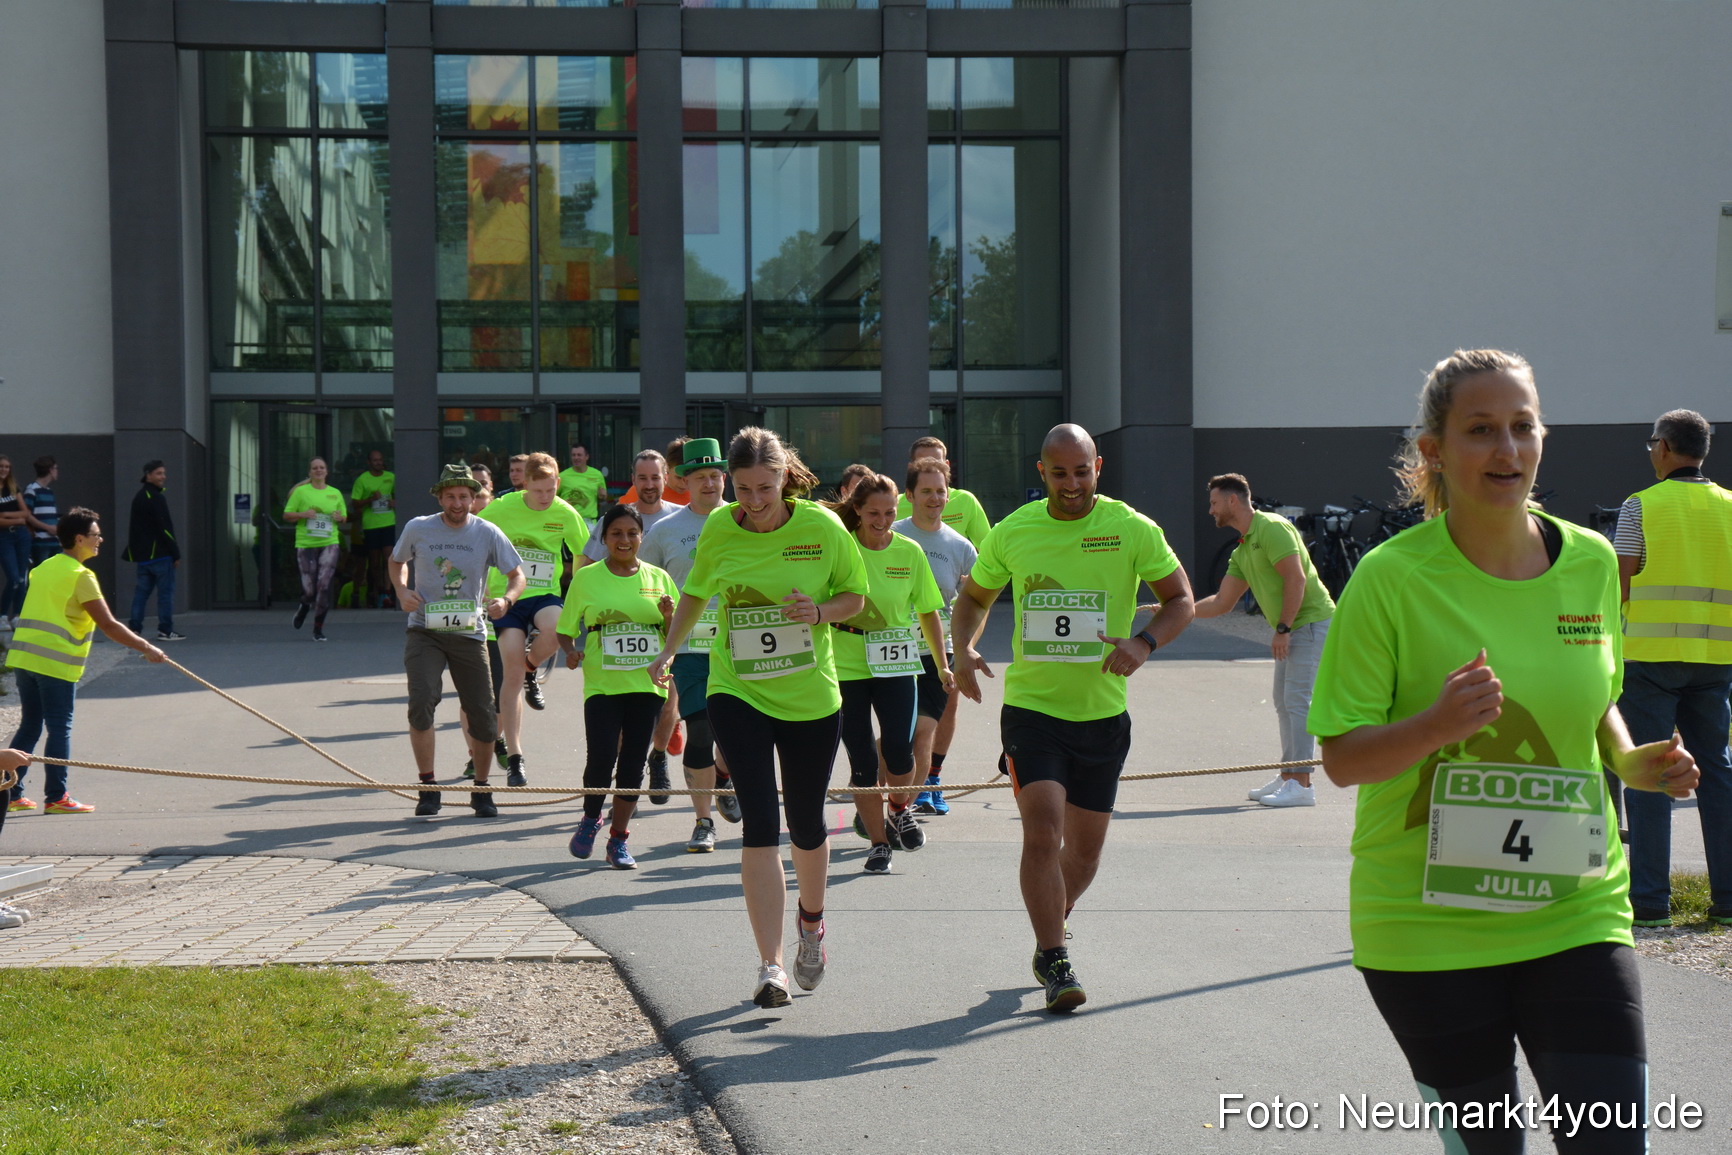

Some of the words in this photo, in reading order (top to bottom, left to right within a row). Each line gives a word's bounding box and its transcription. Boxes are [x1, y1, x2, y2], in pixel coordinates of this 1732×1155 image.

[315, 521, 326, 529] 38
[430, 602, 472, 612] BOCK
[1029, 593, 1098, 609] BOCK
[442, 615, 461, 627] 14
[606, 623, 652, 634] BOCK
[1055, 615, 1071, 637] 8
[615, 637, 648, 653] 150
[760, 632, 777, 654] 9
[1046, 644, 1080, 655] GARY
[880, 644, 908, 661] 151
[614, 657, 650, 665] CECILIA
[753, 657, 794, 672] ANIKA
[874, 663, 917, 672] KATARZYNA
[1447, 771, 1590, 808] BOCK
[1590, 828, 1601, 836] E6
[1502, 819, 1533, 862] 4
[1474, 874, 1553, 899] JULIA
